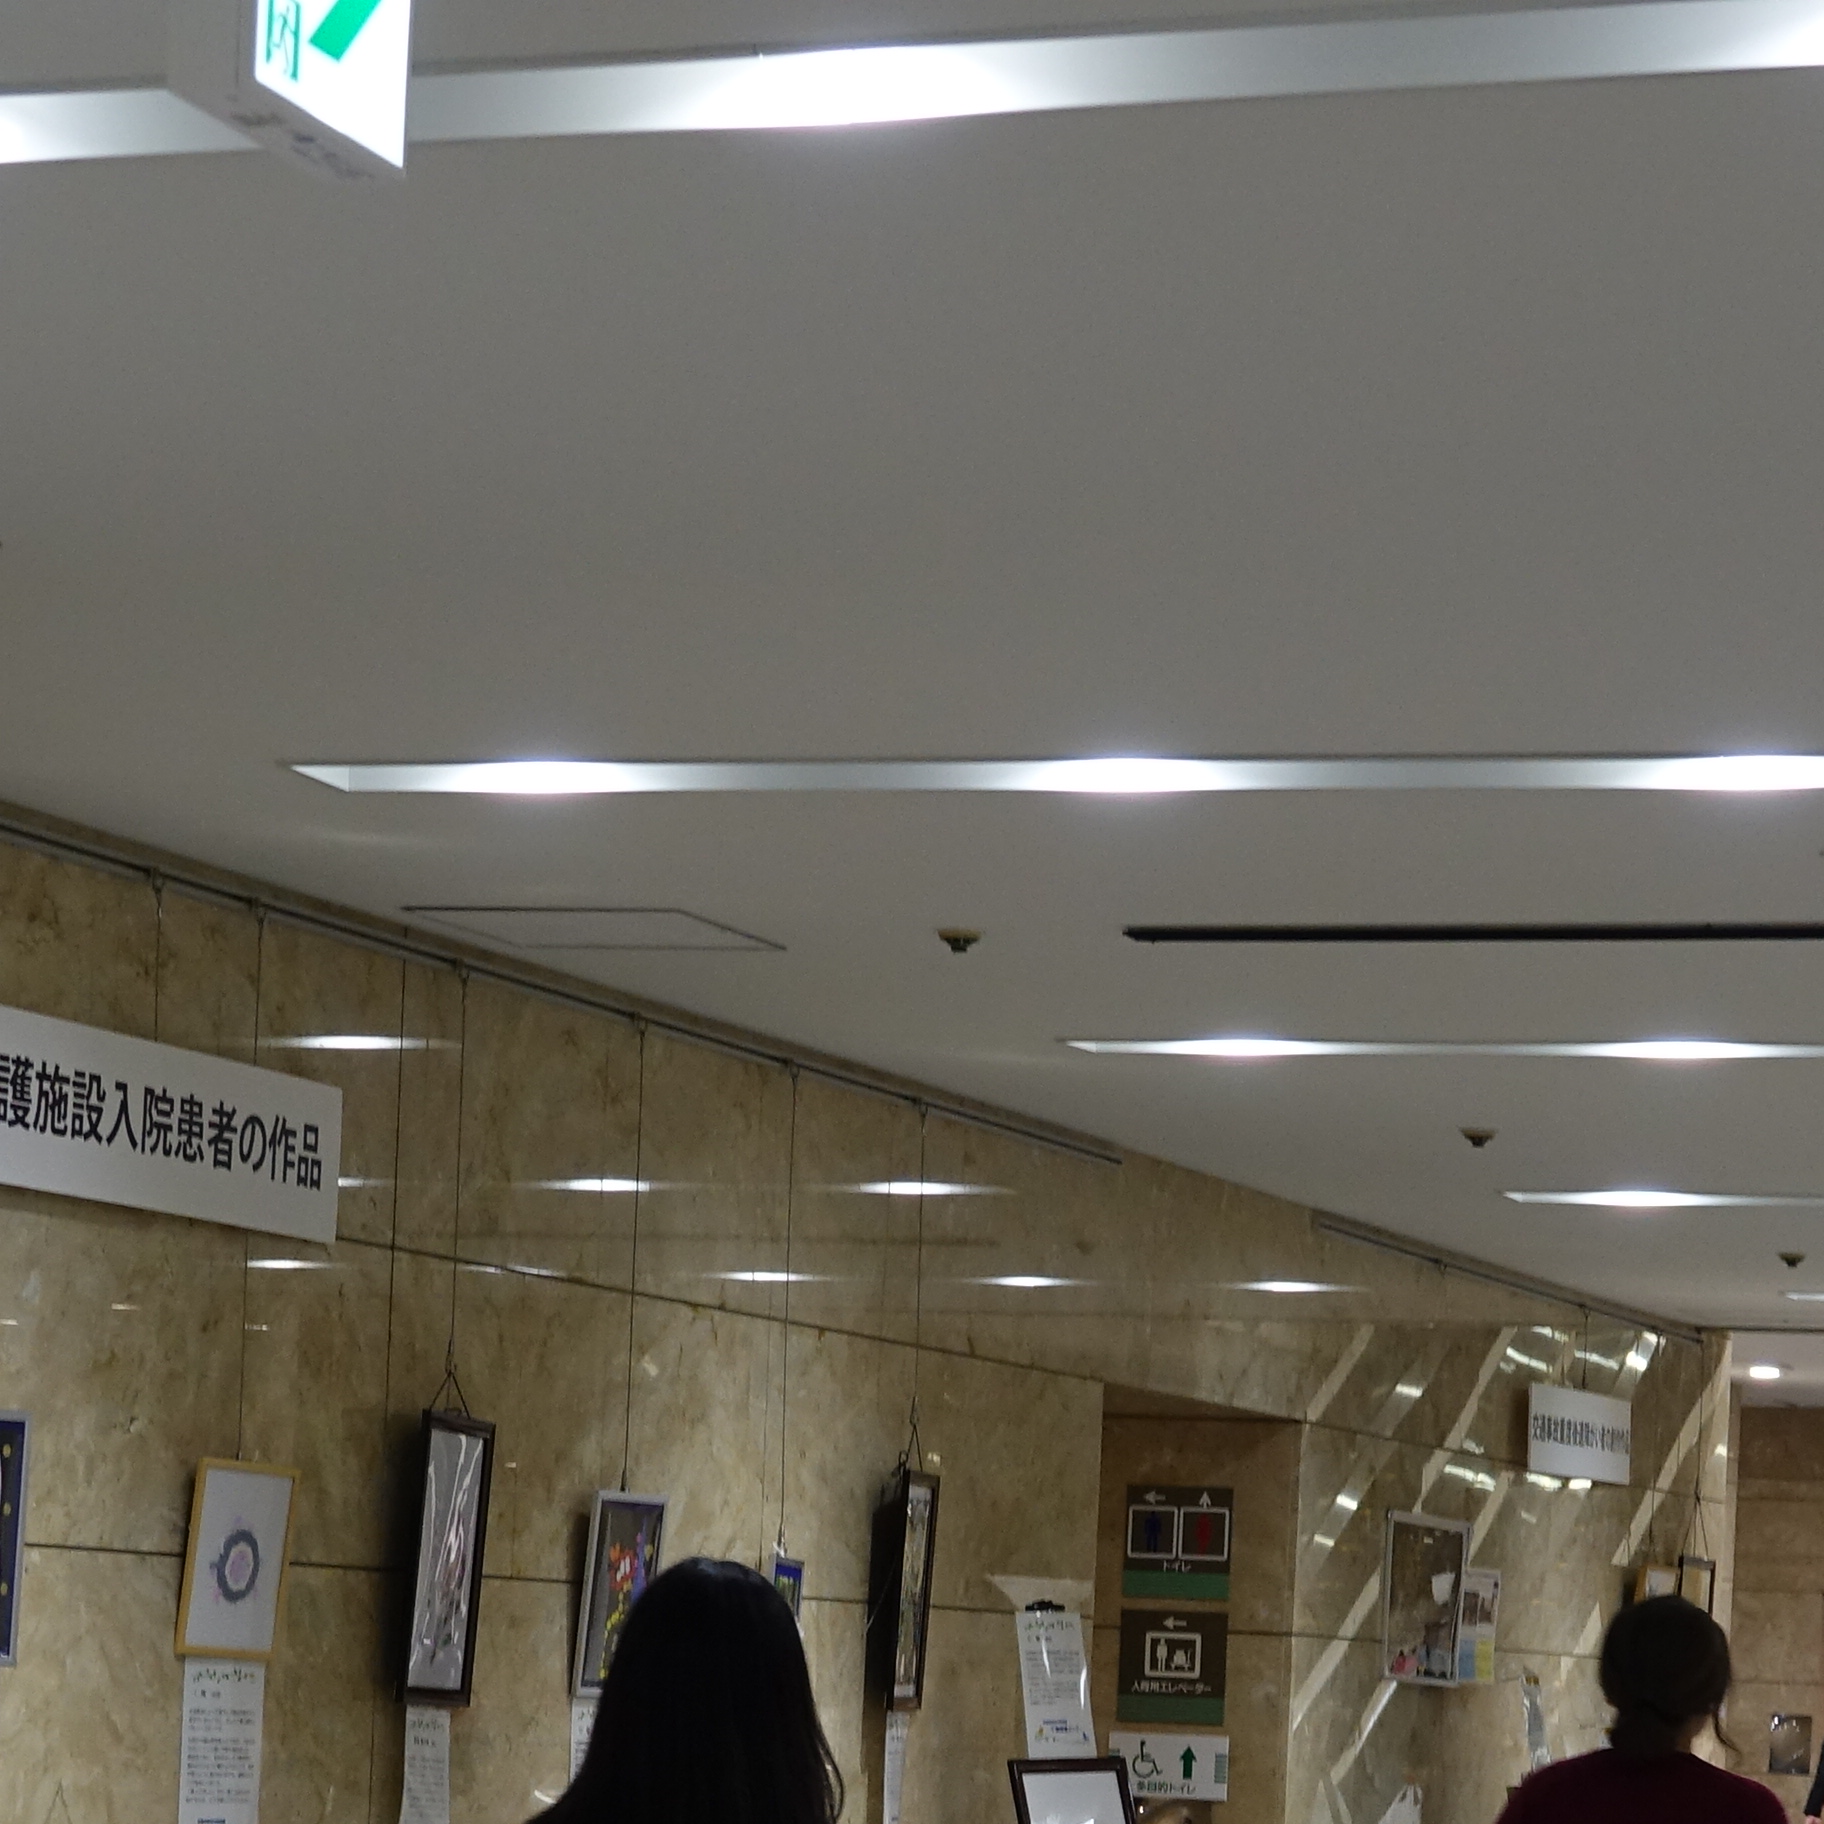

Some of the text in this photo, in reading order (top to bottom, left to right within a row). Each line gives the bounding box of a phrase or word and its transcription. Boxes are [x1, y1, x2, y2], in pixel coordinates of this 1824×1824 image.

[1162, 1559, 1191, 1574] トイレ
[1136, 1780, 1196, 1796] 多目的トイレ
